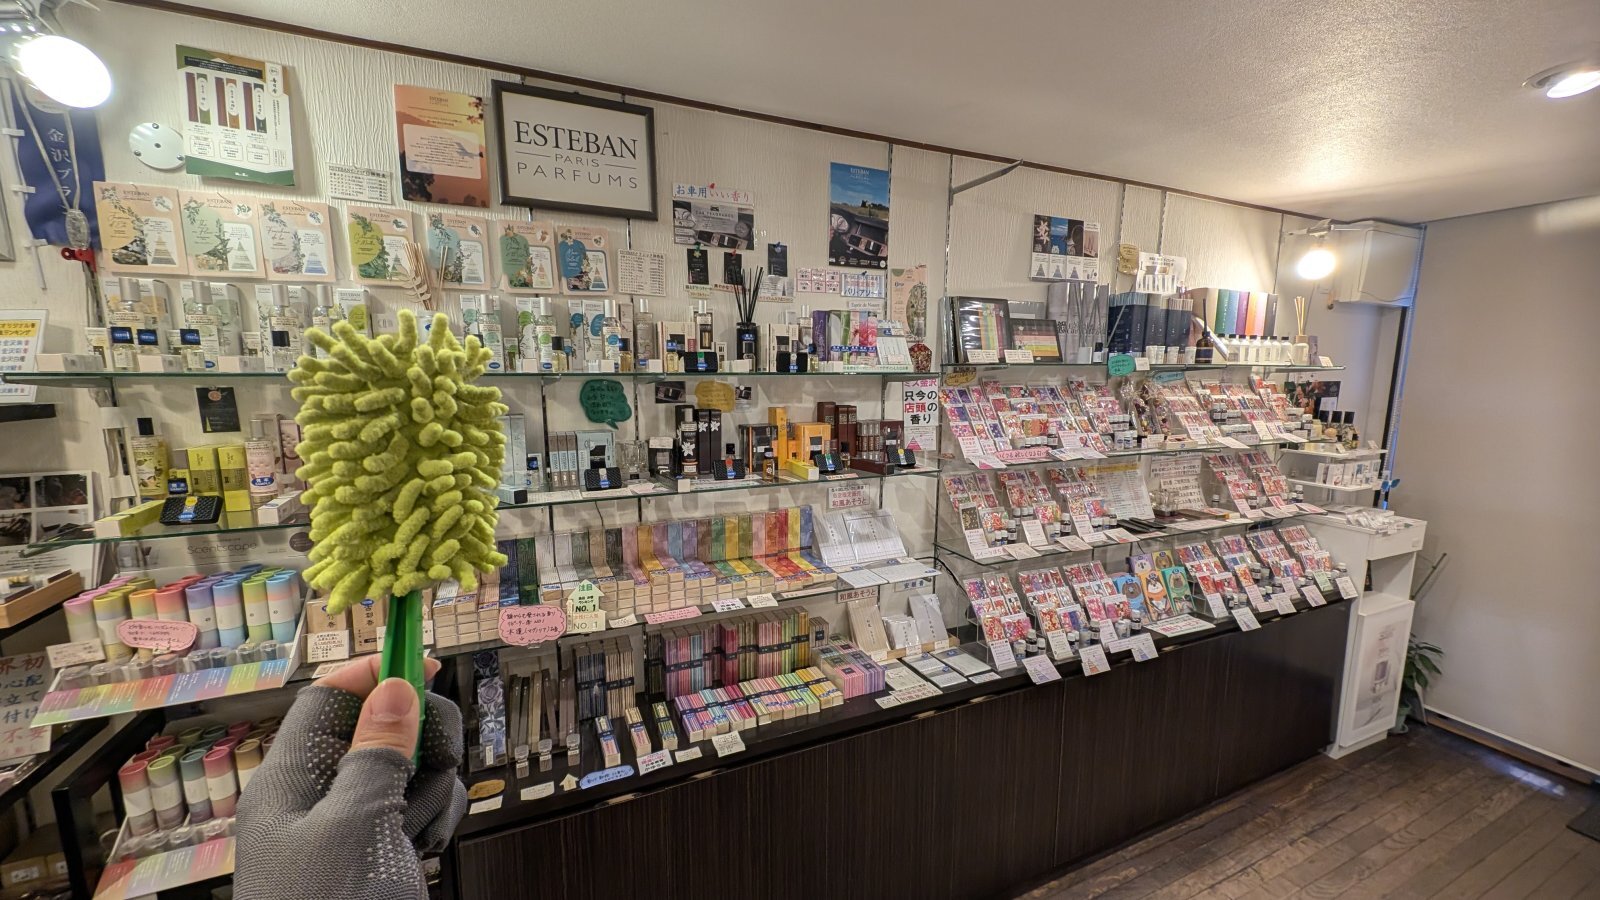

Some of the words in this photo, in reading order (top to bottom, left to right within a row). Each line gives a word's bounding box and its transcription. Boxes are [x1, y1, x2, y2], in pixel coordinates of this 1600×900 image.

[513, 120, 638, 160] ESTEBAN
[555, 153, 600, 168] PARIS
[517, 162, 638, 189] PARFUMS
[676, 184, 749, 202] お車用いい香り
[904, 390, 937, 402] 只今の
[904, 402, 937, 413] 店頭の
[910, 414, 931, 425] 香り
